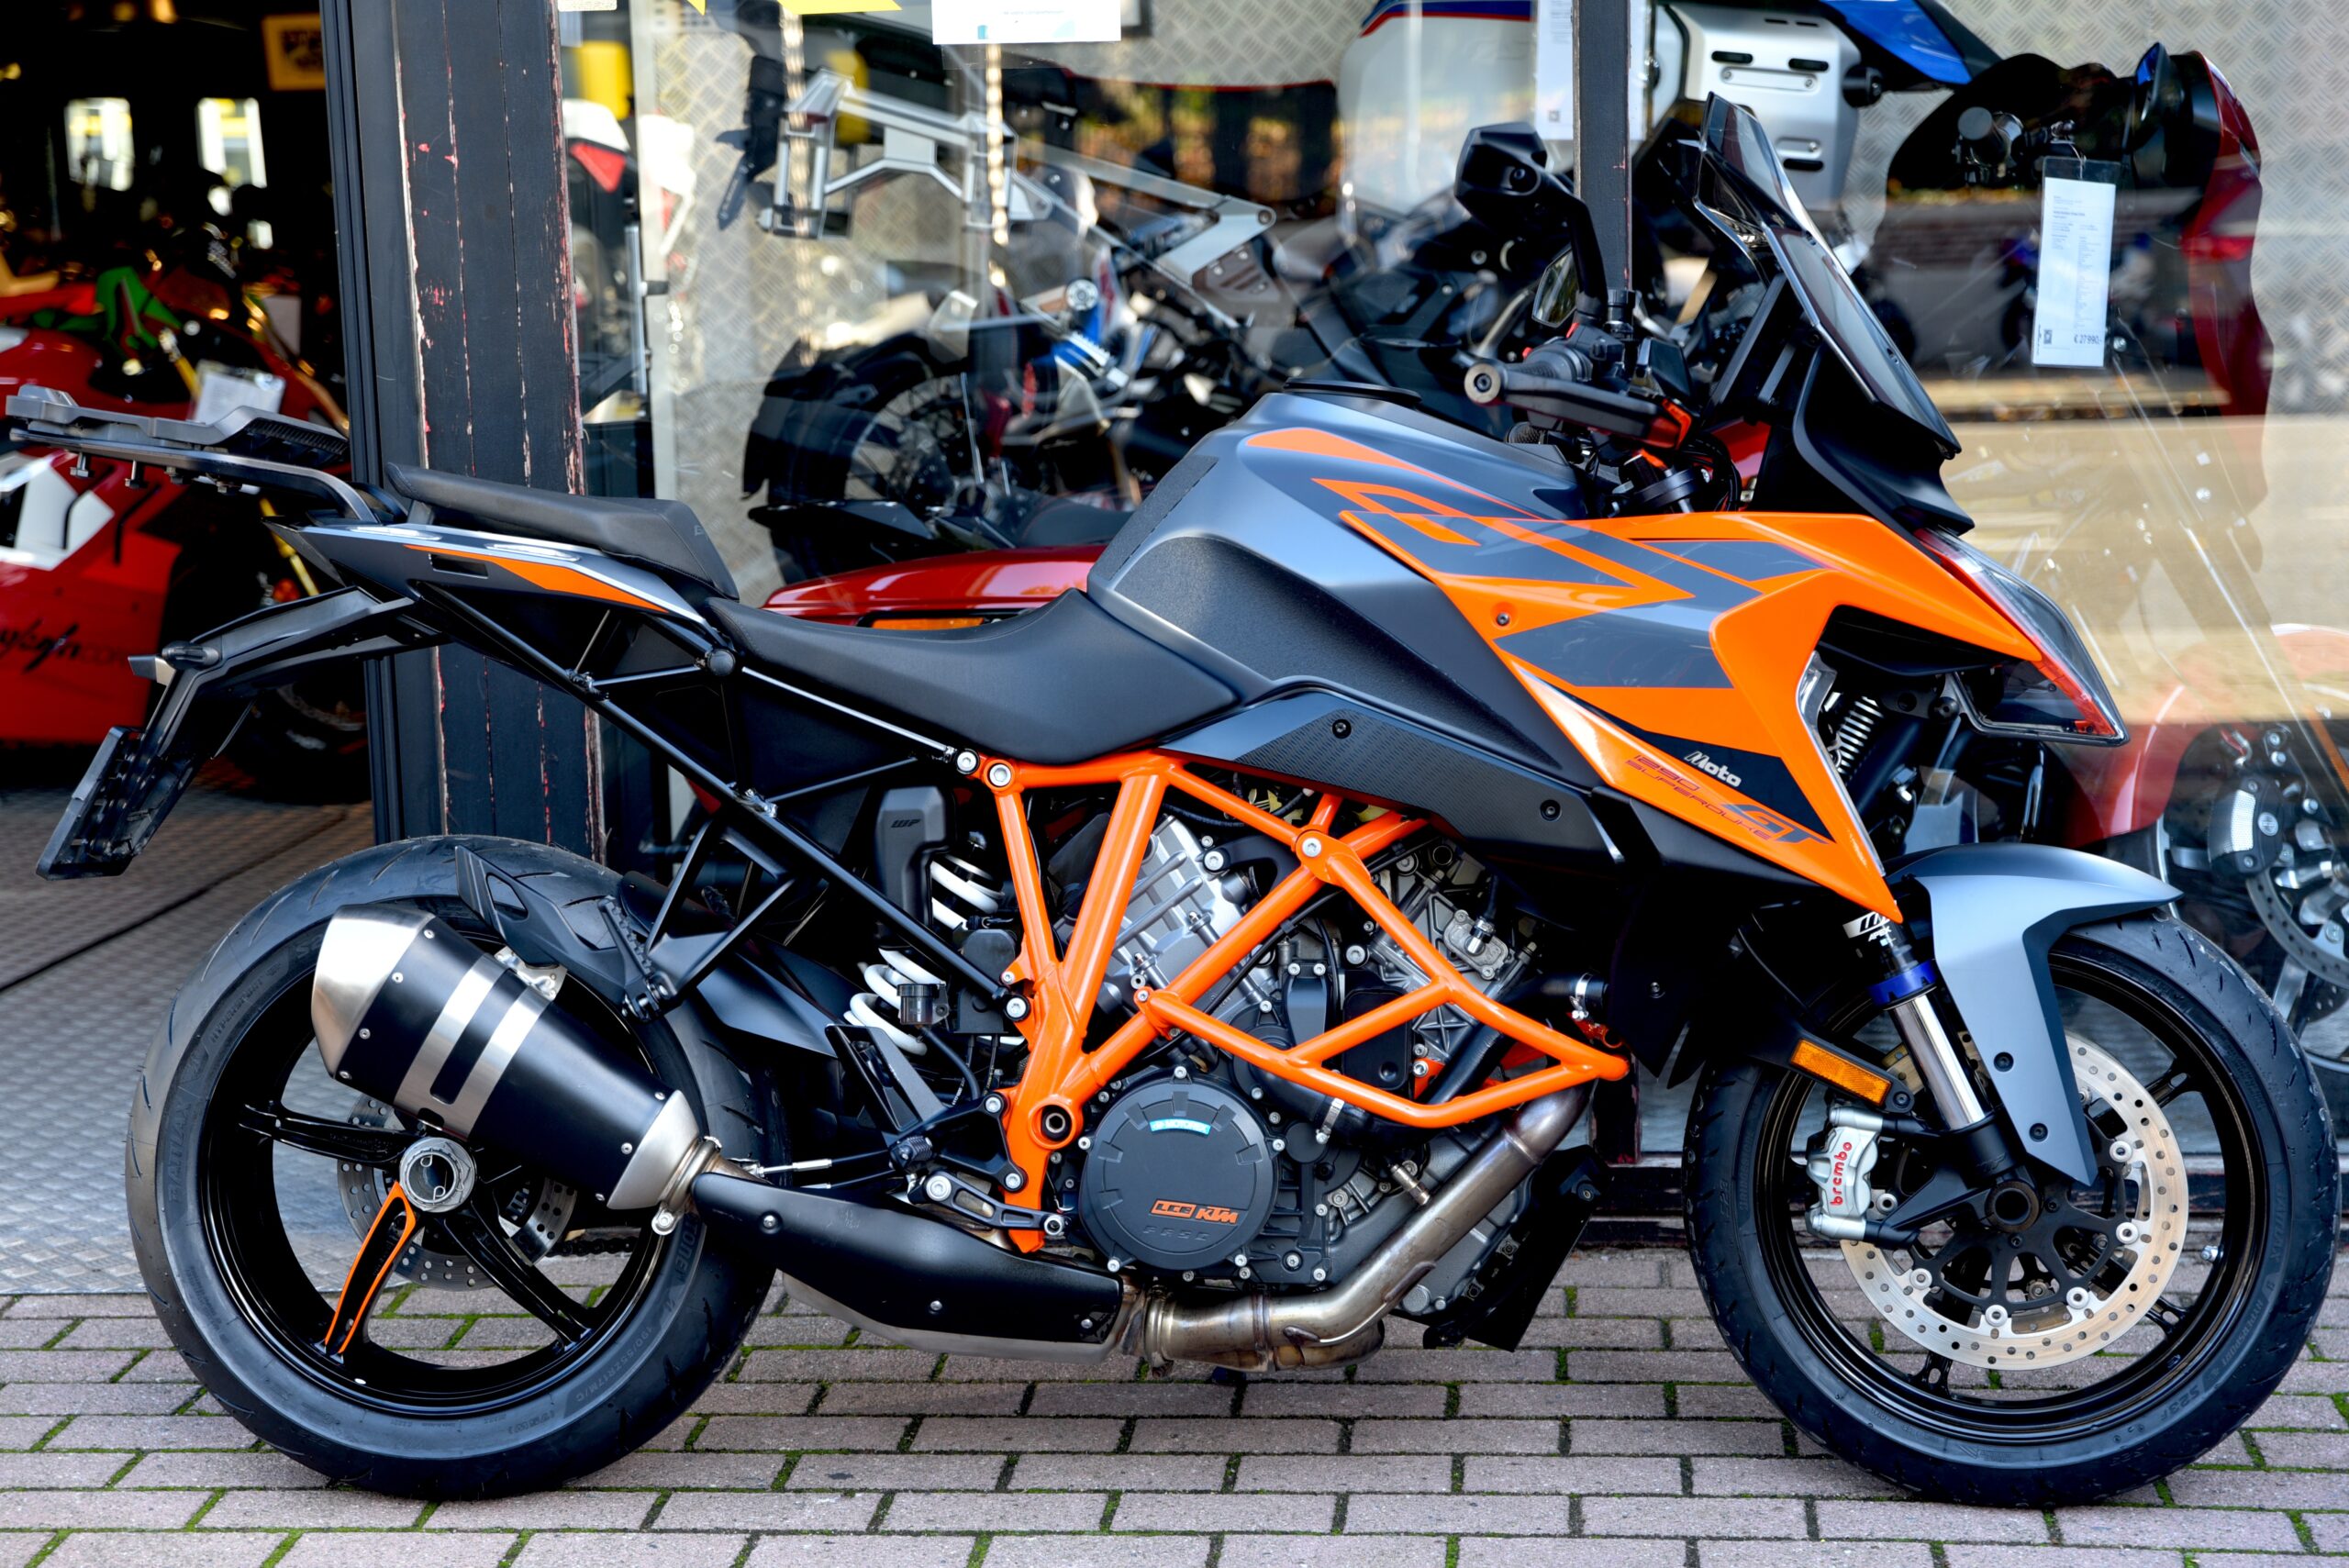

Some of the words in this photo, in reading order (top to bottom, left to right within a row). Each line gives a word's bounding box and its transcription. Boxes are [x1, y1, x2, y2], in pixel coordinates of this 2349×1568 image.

[1634, 754, 1700, 792] 1290
[1685, 751, 1742, 788] Moto
[1721, 803, 1830, 845] GT
[1830, 1142, 1852, 1206] brembo
[1195, 1206, 1240, 1225] KTM
